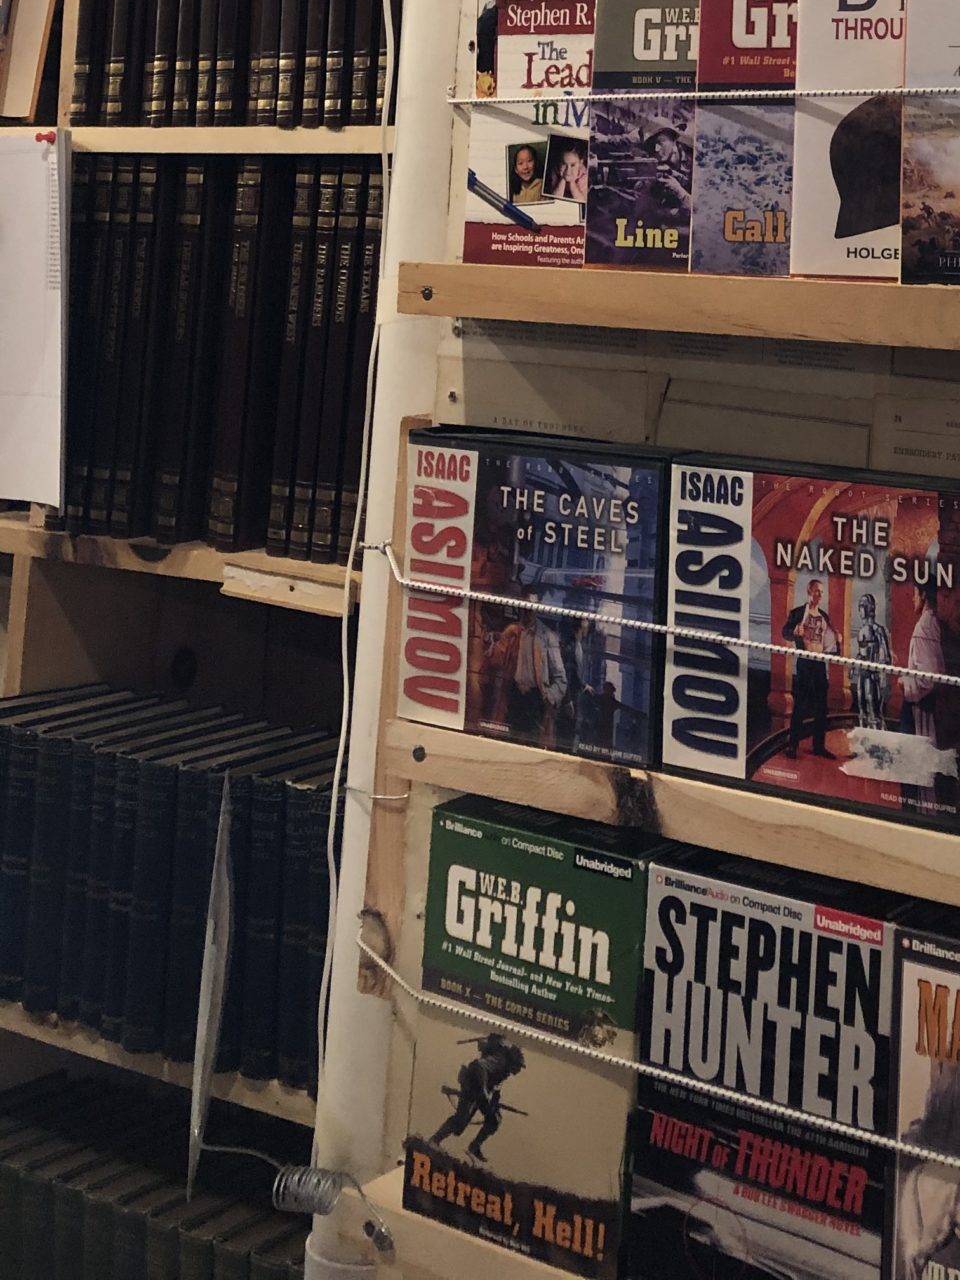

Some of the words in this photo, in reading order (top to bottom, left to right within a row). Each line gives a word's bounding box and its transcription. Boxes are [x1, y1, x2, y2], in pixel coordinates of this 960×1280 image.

[506, 4, 571, 32] Stephen
[574, 3, 592, 26] R.
[537, 40, 568, 62] The
[492, 232, 507, 242] How
[507, 232, 534, 243] Schools
[534, 234, 548, 243] and
[549, 235, 575, 245] Parents
[614, 218, 679, 249] Line
[723, 209, 787, 244] Call
[503, 243, 533, 254] Inspiring
[534, 244, 570, 255] Greatness,
[416, 449, 472, 482] ISAAC
[500, 485, 546, 514] THE
[558, 493, 640, 525] CAVES
[680, 470, 745, 507] ISAAC
[516, 524, 533, 542] of
[543, 521, 625, 554] STEEL
[833, 516, 889, 547] THE
[776, 543, 875, 579] NAKED
[891, 558, 954, 589] SUN
[403, 484, 470, 714] ASIMOV
[671, 508, 744, 760] ASIMOV
[445, 820, 483, 839] Brilliance
[511, 838, 546, 859] Compact
[546, 845, 565, 861] Disc
[575, 855, 632, 879] Unabridged
[478, 871, 524, 906] W.E.B.
[444, 862, 612, 986] Griffin
[730, 895, 742, 906] on
[742, 896, 782, 917] Compact
[782, 905, 803, 922] Disc
[815, 915, 883, 941] Unabridged
[655, 894, 883, 1033] STEPHEN
[649, 970, 877, 1131] HUNTER
[649, 1111, 714, 1164] NIGHT
[712, 1144, 731, 1169] OF
[734, 1128, 869, 1216] THUNDER
[409, 1151, 521, 1237] Retreat,
[532, 1198, 606, 1261] Hell!
